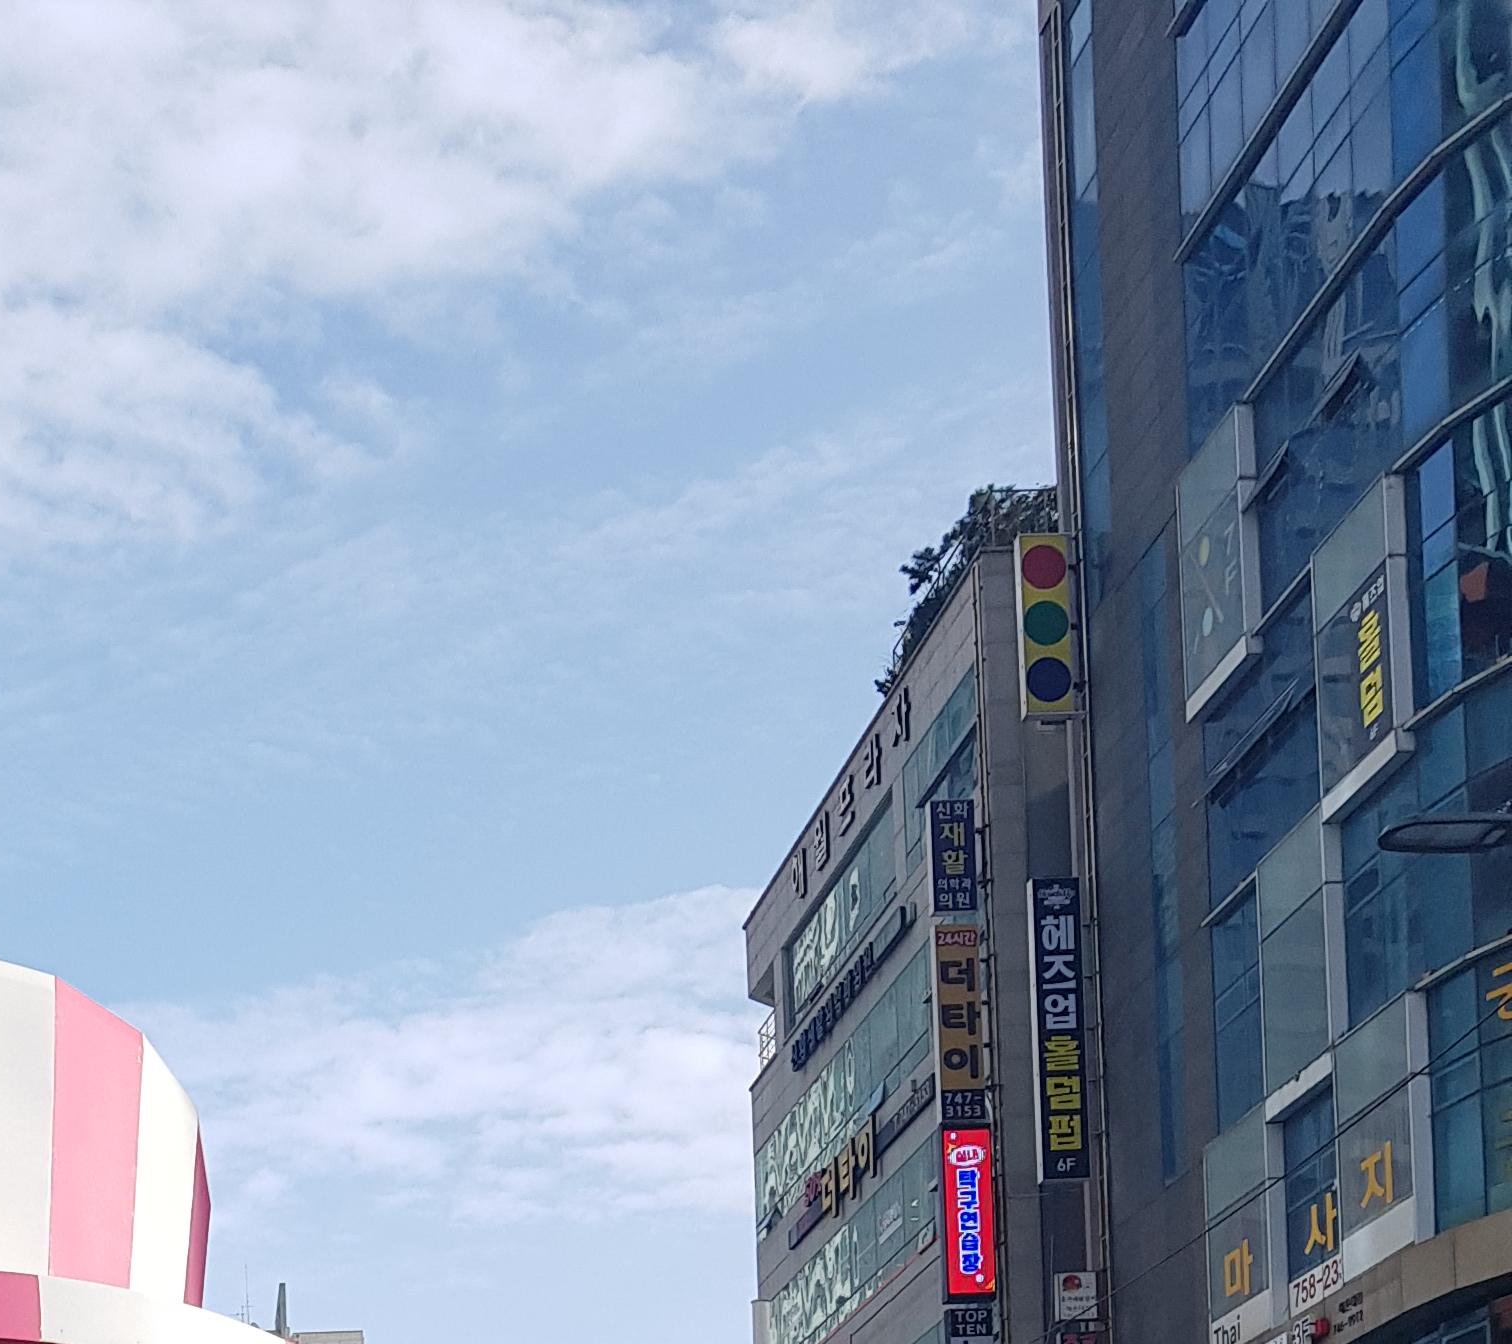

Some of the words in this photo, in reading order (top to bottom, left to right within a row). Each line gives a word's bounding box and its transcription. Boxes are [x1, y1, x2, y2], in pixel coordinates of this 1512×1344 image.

[936, 802, 970, 819] 신화
[940, 822, 968, 876] 재활
[937, 878, 972, 891] 의학과
[939, 893, 971, 909] 의원
[937, 930, 978, 947] 24시간
[1040, 914, 1078, 1030] 헤즈업
[940, 957, 982, 1080] 더타이
[1043, 1035, 1082, 1150] 홀덤펍
[946, 1106, 982, 1118] 3153
[821, 1114, 876, 1218] 더타이
[1057, 1158, 1076, 1171] 6F
[1293, 1258, 1342, 1308] 758-23
[954, 1310, 988, 1323] TOP
[955, 1324, 988, 1335] TEN
